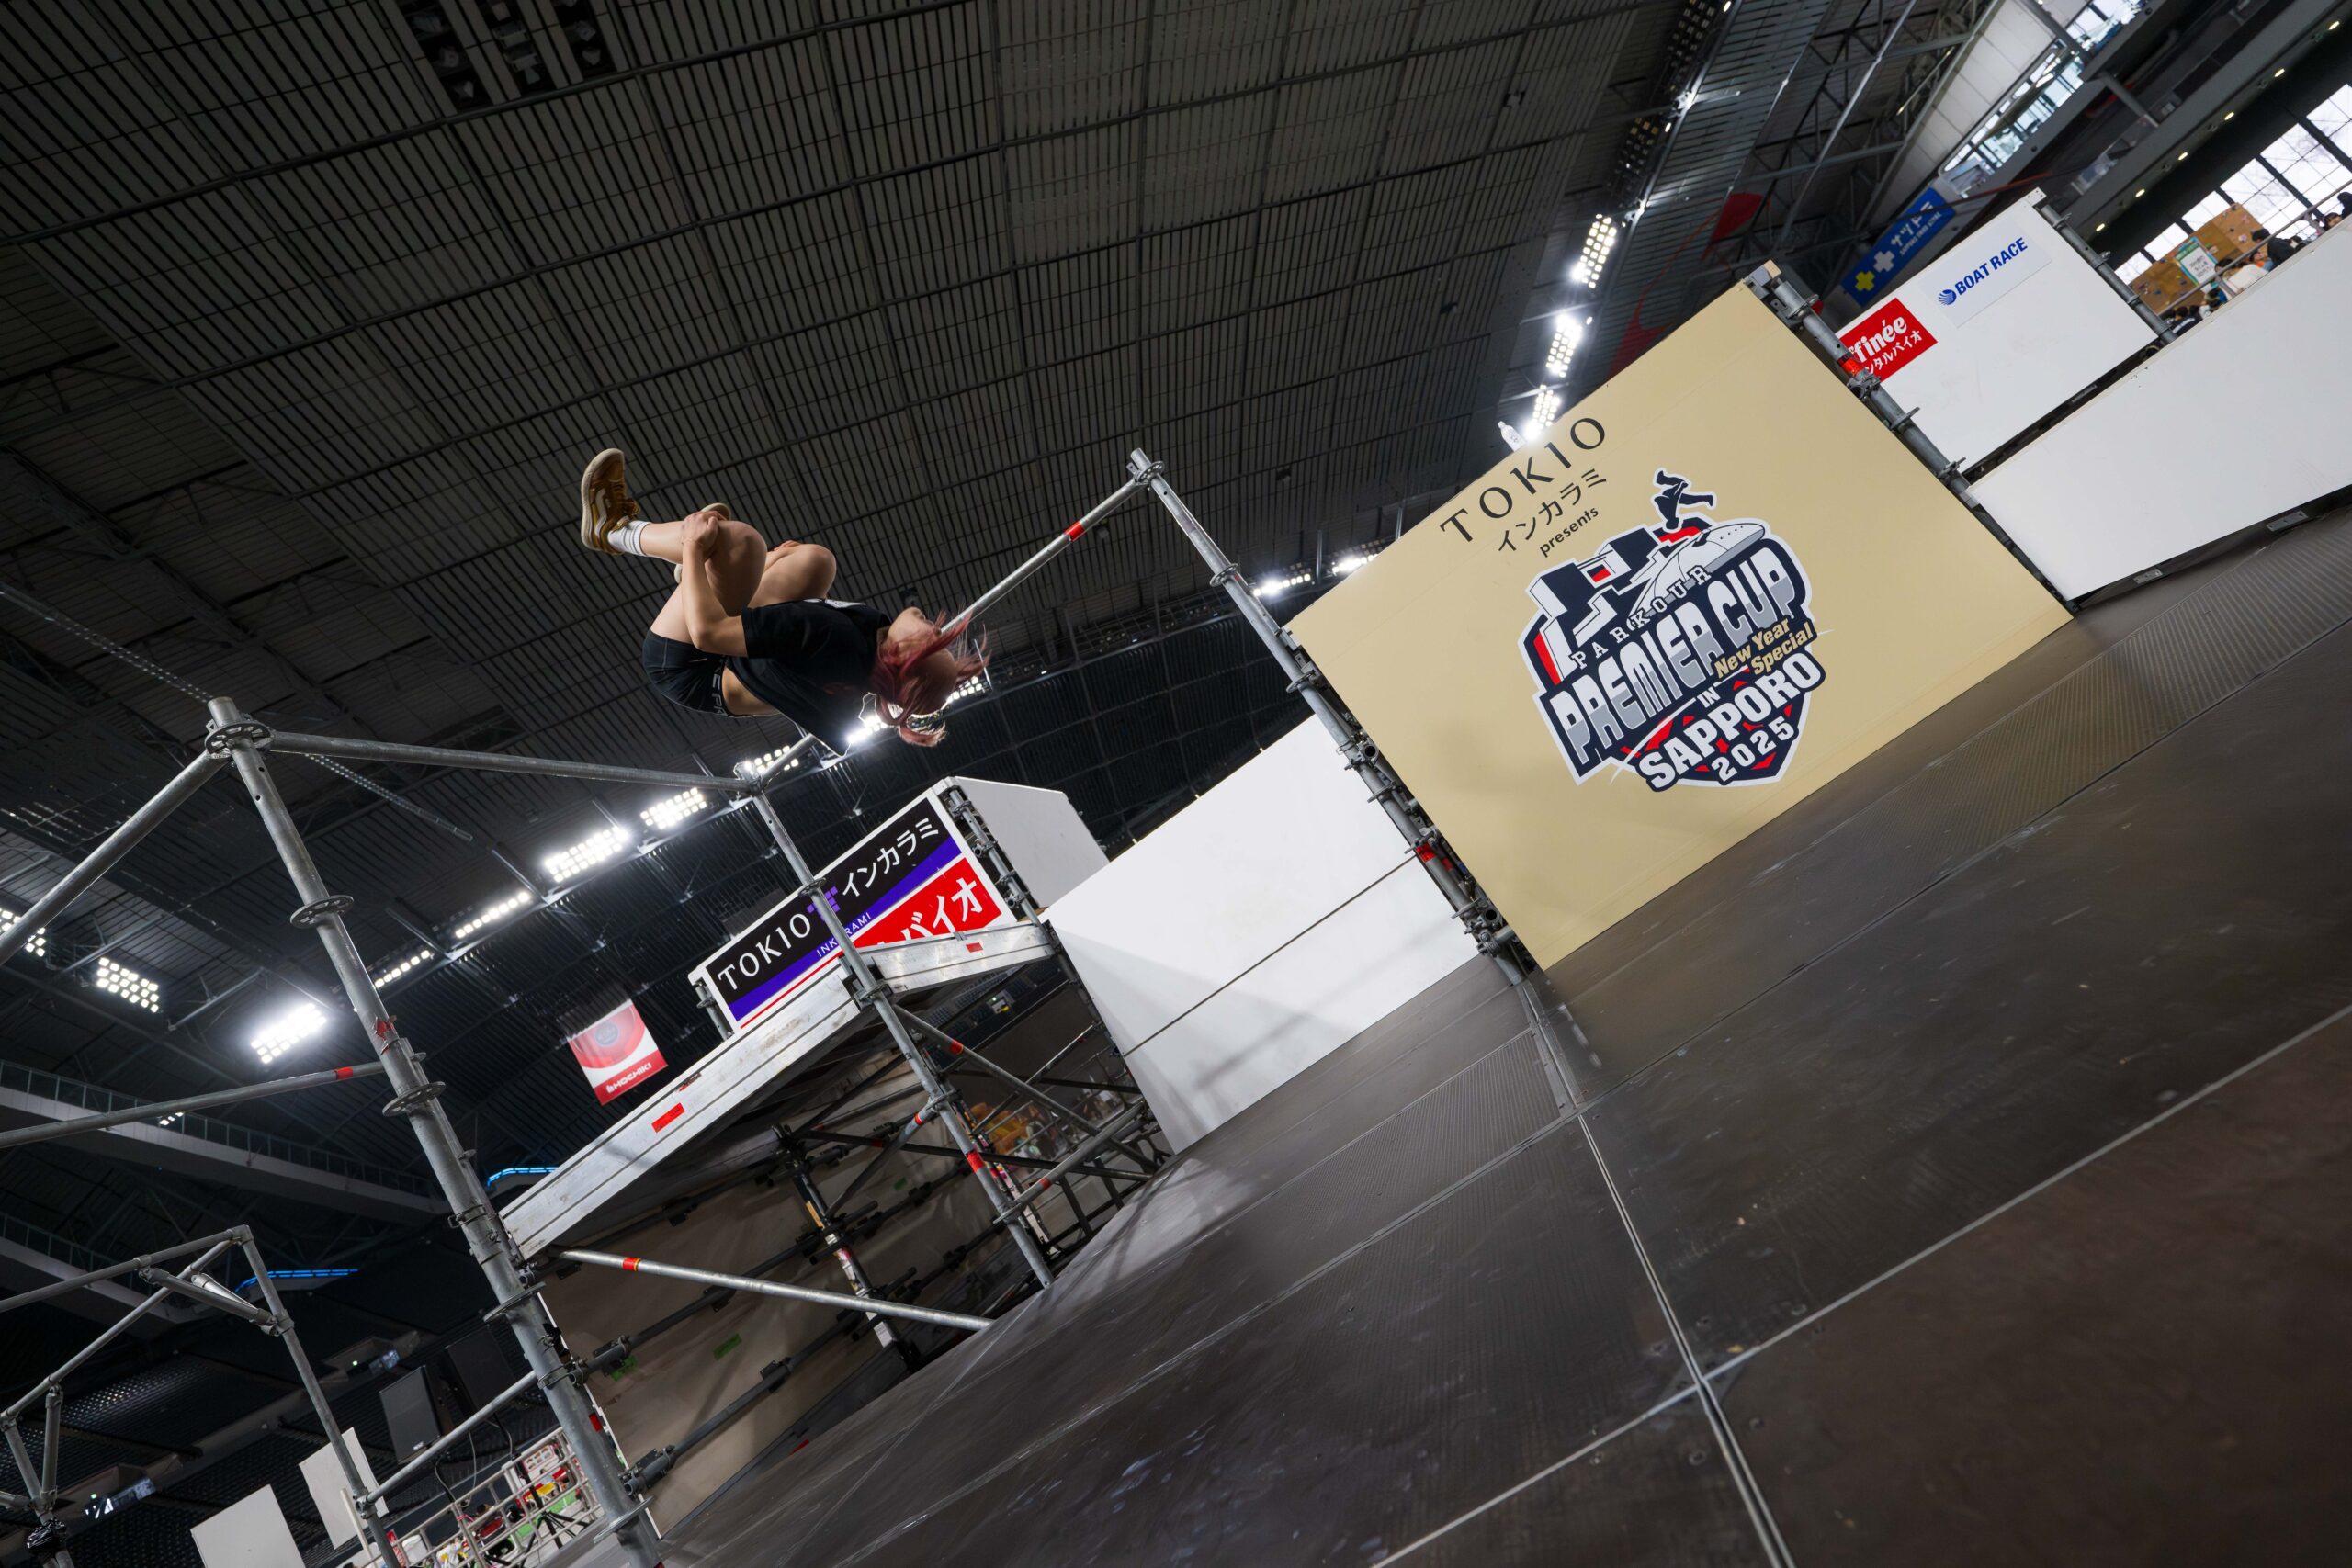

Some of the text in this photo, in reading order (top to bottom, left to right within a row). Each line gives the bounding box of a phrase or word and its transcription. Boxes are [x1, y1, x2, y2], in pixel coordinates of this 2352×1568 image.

[1954, 237, 2028, 295] BOAT RACE
[1440, 418, 1605, 542] TOKIO
[1498, 468, 1606, 551] インカラミ
[1540, 507, 1599, 558] presents
[1569, 565, 1712, 670] PARKOUR
[1714, 618, 1791, 679] New Year
[1750, 622, 1814, 675] Special
[1549, 547, 1796, 765] PREMIER CUP
[1638, 652, 1821, 789] SAPPORO
[1697, 685, 1721, 708] IN
[1711, 716, 1794, 782] 2025
[718, 817, 939, 990] TOKIO インカラミ
[816, 912, 873, 957] INKRAMI
[877, 876, 983, 945] バイオ
[612, 1062, 652, 1090] HOCHIKI
